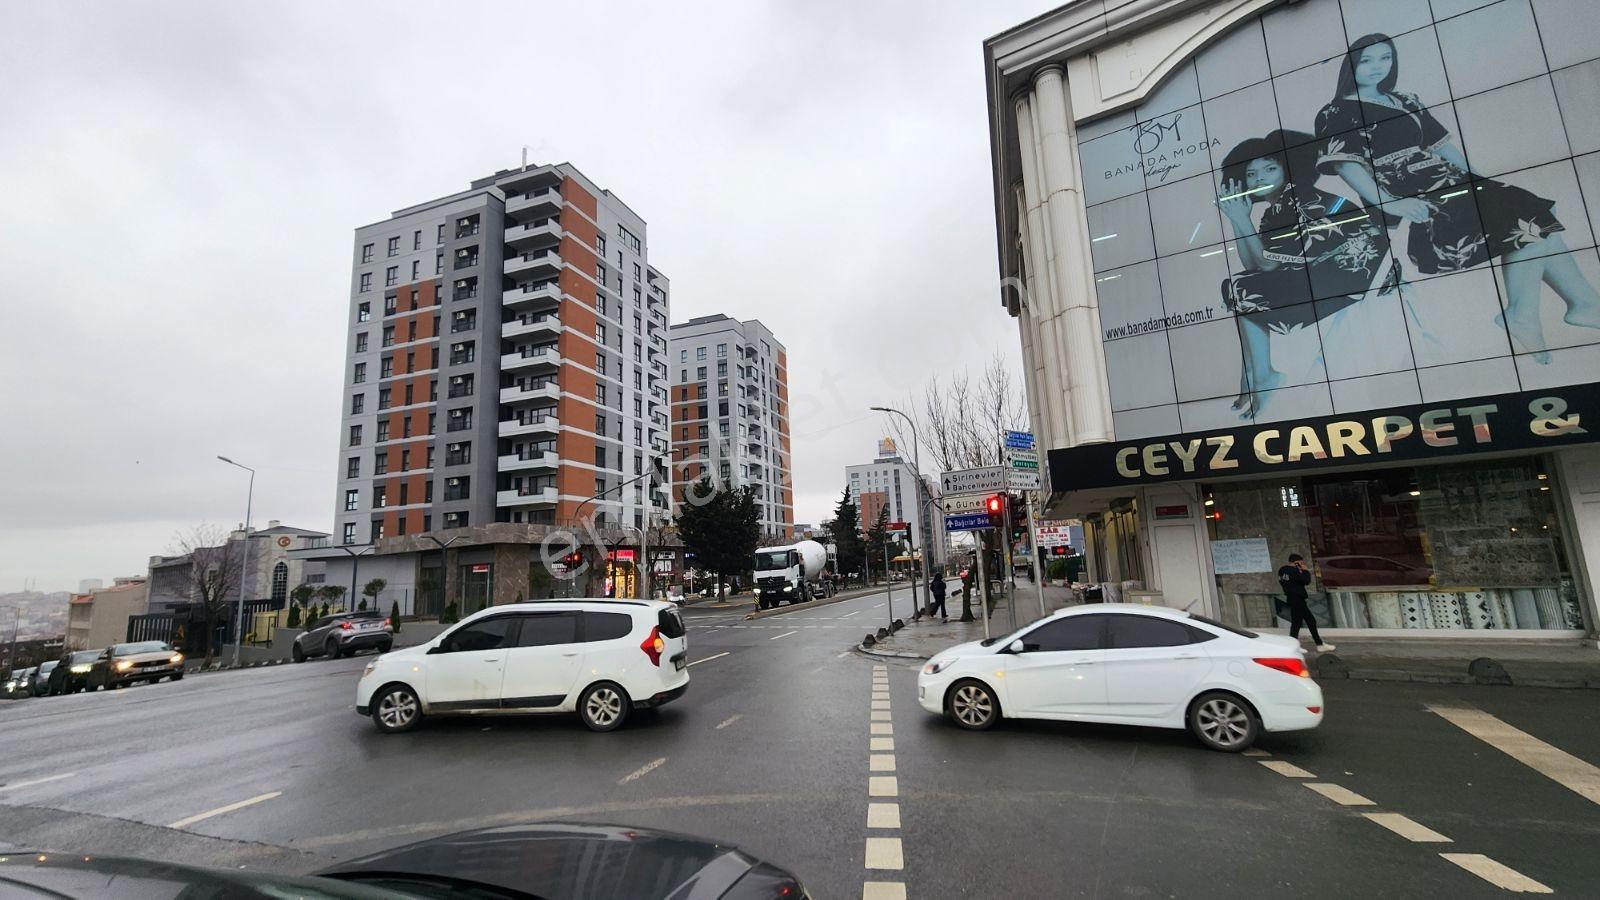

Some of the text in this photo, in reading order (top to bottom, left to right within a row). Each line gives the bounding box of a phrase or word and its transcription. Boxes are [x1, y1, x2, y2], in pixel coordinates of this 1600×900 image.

[1104, 137, 1221, 180] BANADA MODA
[1145, 163, 1181, 182] design
[1106, 306, 1214, 339] www.banadamoda.com.tr
[1115, 397, 1588, 478] CEYZ CARPET &
